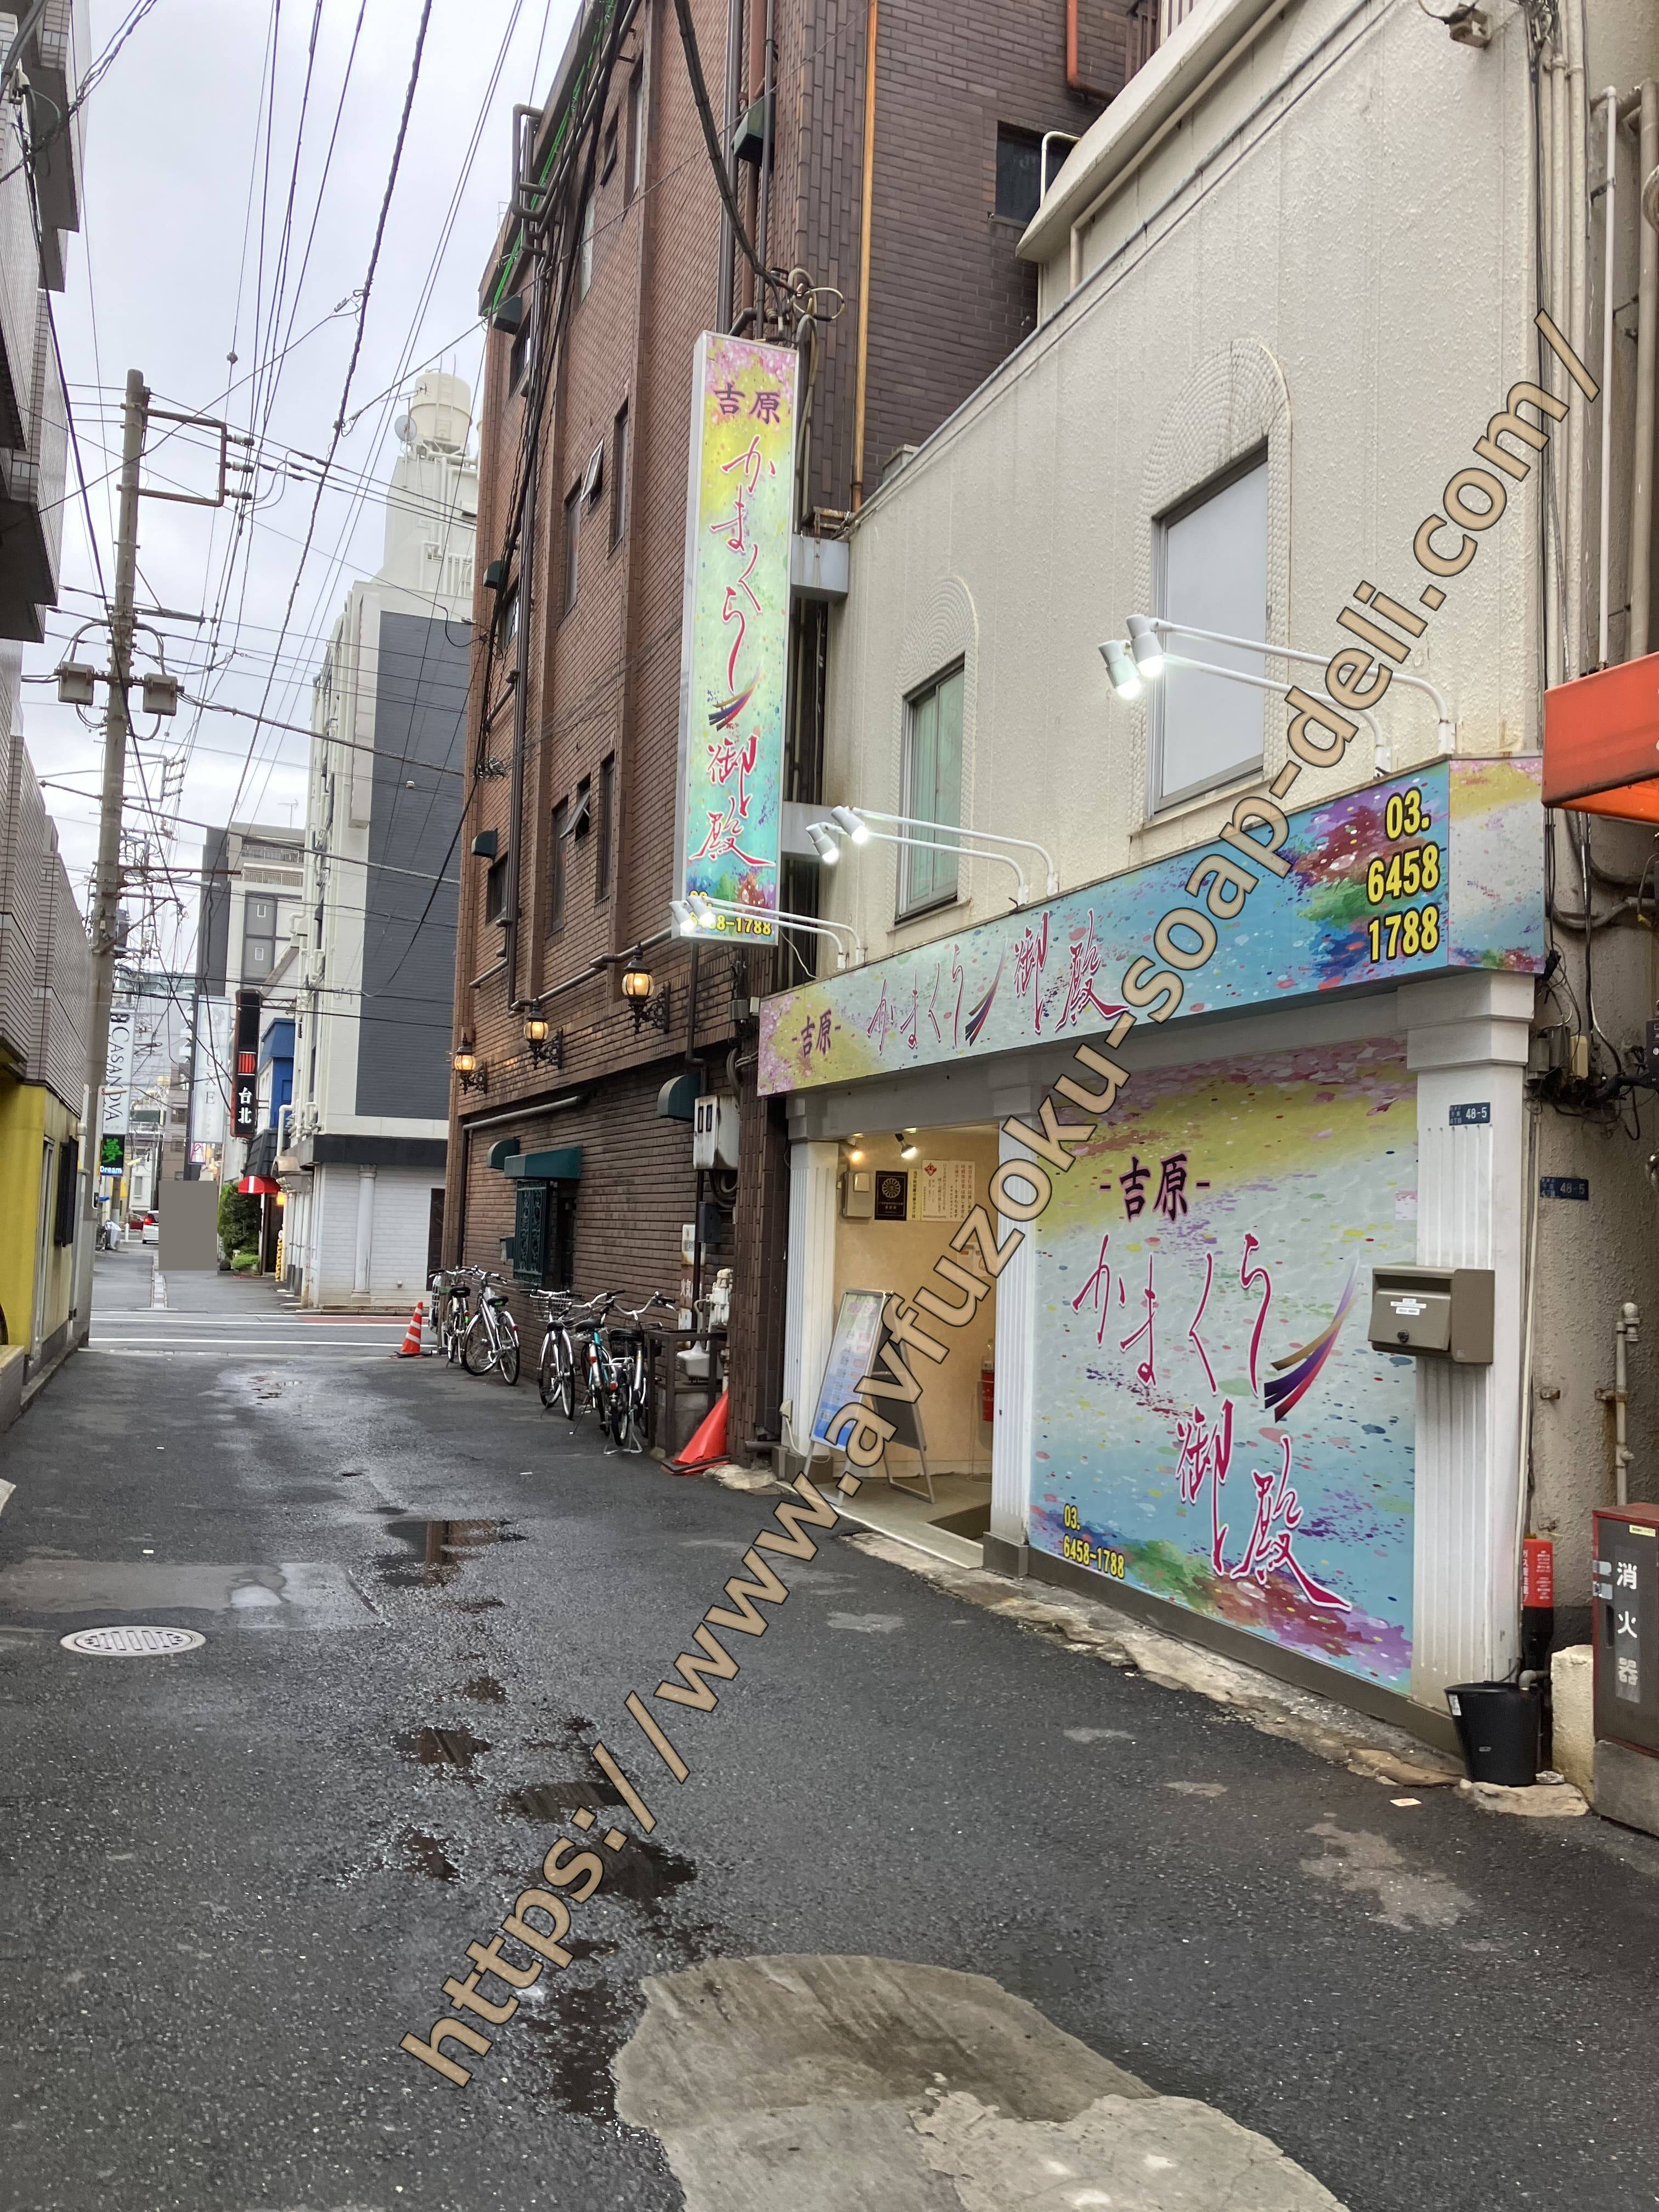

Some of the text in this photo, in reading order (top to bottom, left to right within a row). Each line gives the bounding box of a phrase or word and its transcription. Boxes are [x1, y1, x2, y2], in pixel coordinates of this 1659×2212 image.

[714, 384, 781, 424] 吉原
[1386, 786, 1431, 840] 03.
[1367, 842, 1441, 905] 6458
[1368, 904, 1441, 964] 1788
[238, 1087, 252, 1124] 台北
[1465, 1107, 1487, 1120] 48-5
[99, 1165, 122, 1174] Dream
[101, 1138, 123, 1163] 夢
[1063, 1503, 1081, 1531] 03.
[1063, 1533, 1125, 1579] 6458-1788
[1616, 1562, 1638, 1686] 消火器
